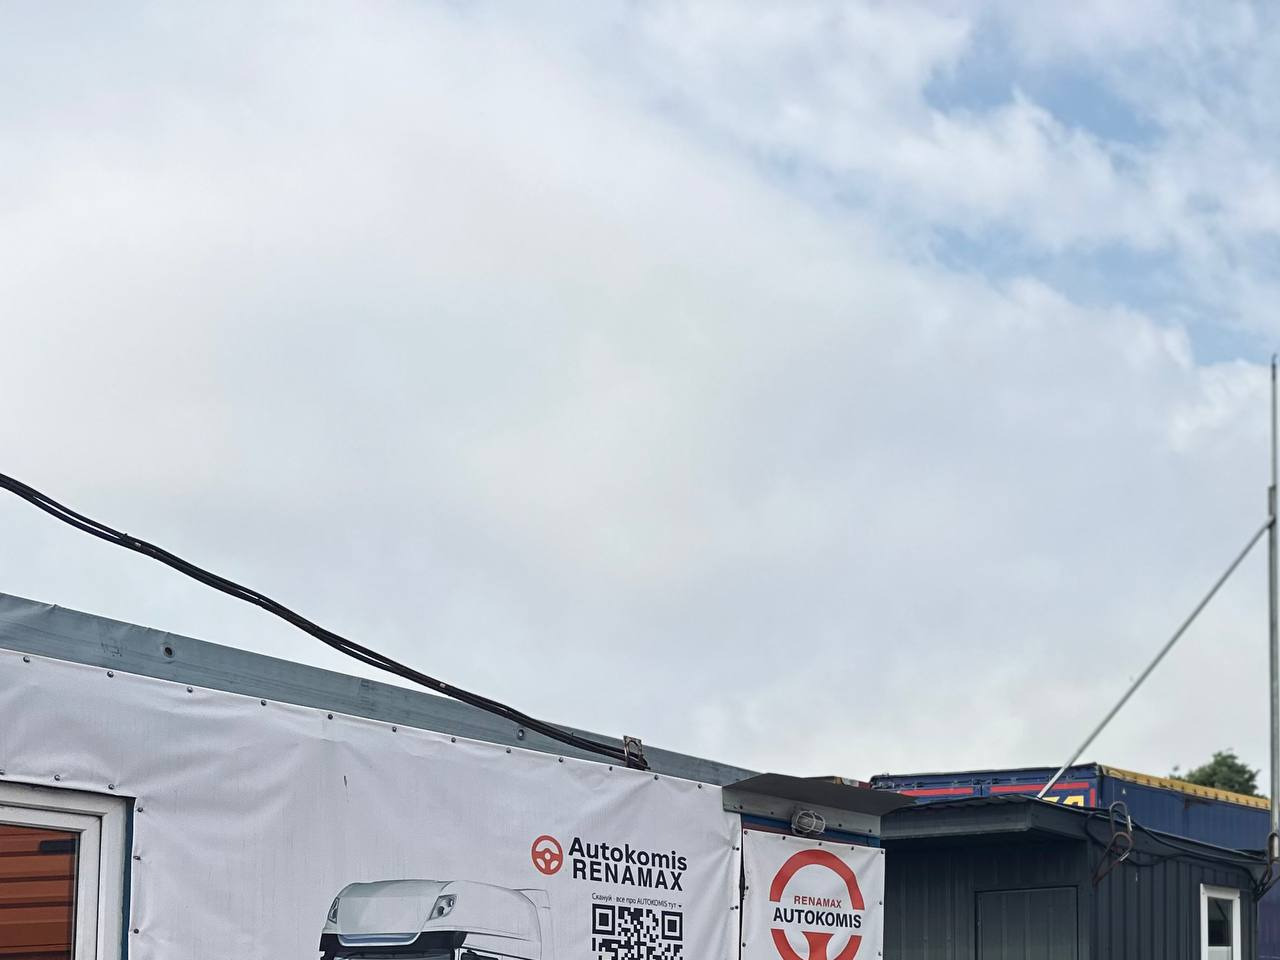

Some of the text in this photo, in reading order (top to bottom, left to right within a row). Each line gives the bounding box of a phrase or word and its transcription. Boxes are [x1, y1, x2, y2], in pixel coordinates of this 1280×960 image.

[568, 837, 688, 871] Autokomis
[572, 858, 683, 891] RENAMAX
[793, 895, 842, 907] RENAMAX
[773, 906, 863, 929] AUTOKOMIS
